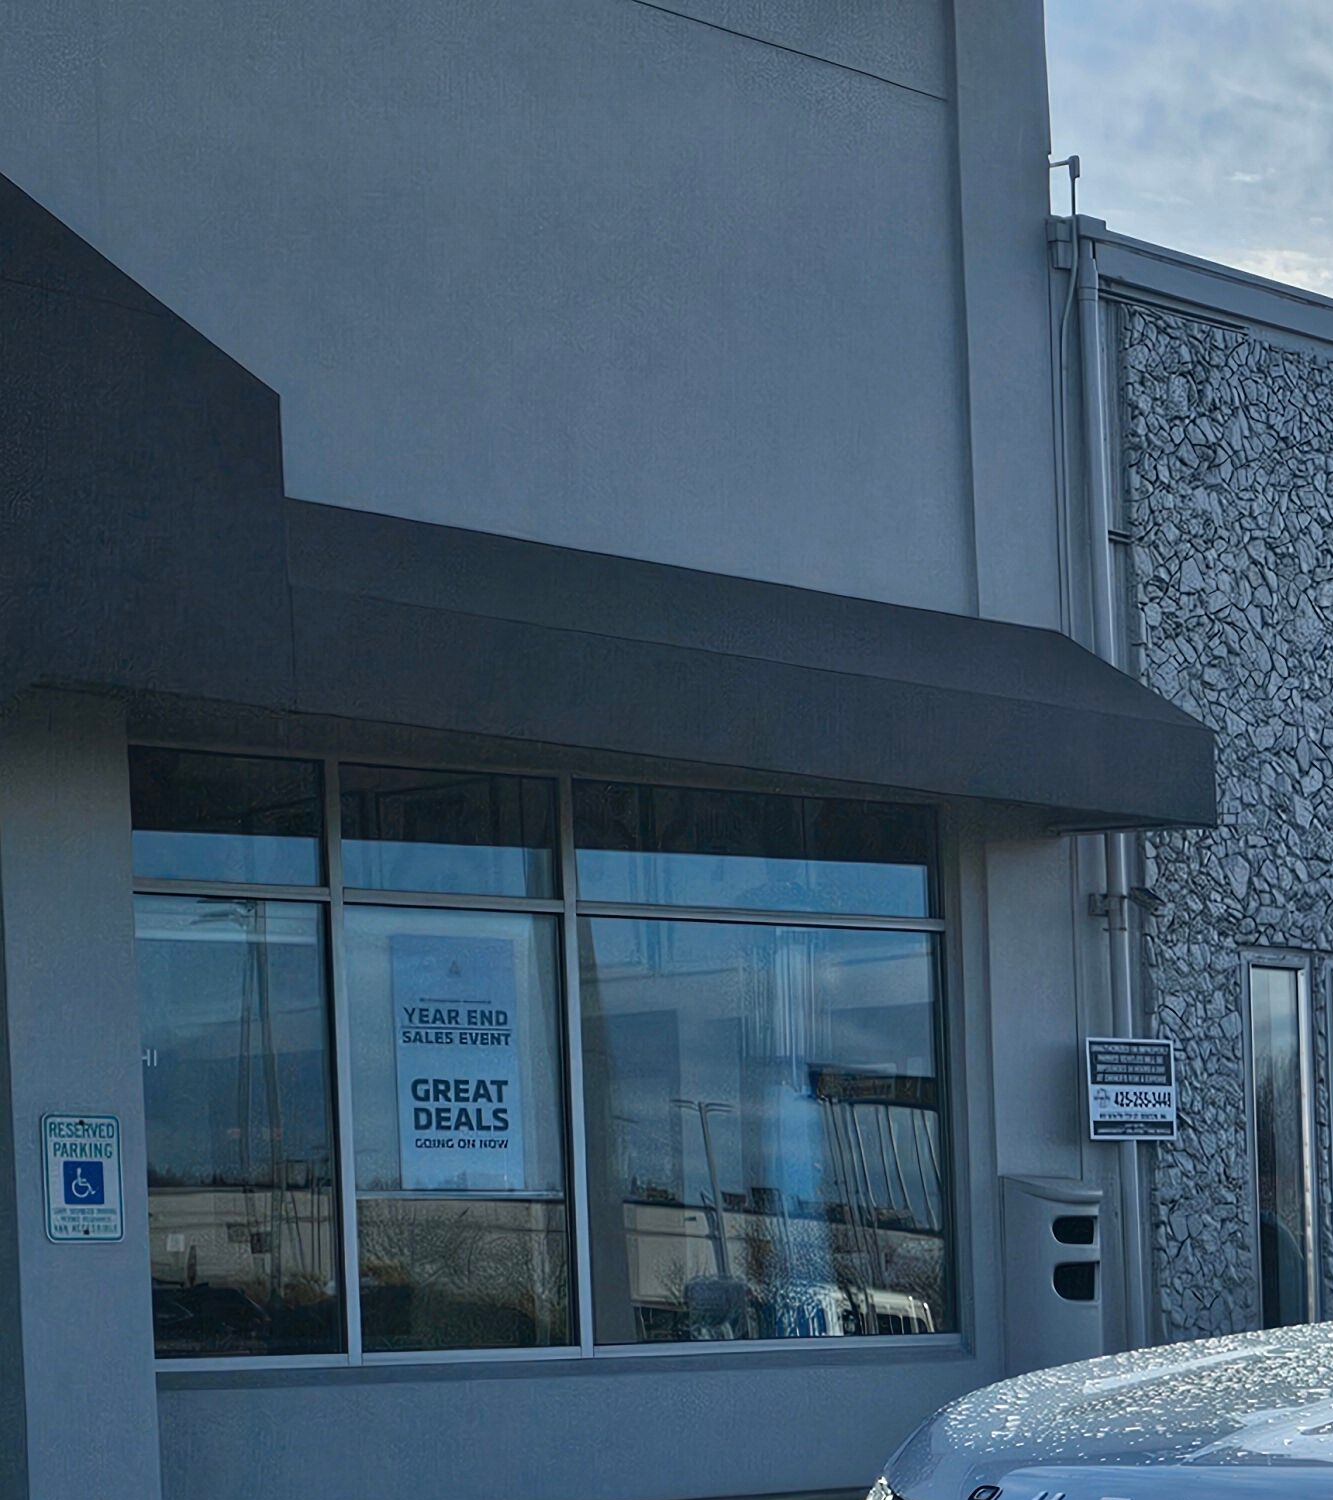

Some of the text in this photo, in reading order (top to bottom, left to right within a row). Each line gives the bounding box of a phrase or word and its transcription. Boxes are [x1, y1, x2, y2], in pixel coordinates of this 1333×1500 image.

[403, 1007, 508, 1027] YEAR END
[402, 1030, 511, 1046] SALES EVENT
[411, 1079, 509, 1104] GREAT
[414, 1107, 510, 1132] DEALS
[49, 1121, 115, 1139] RESERVED
[53, 1141, 113, 1159] PARKING
[415, 1138, 509, 1150] GOING ON NOW
